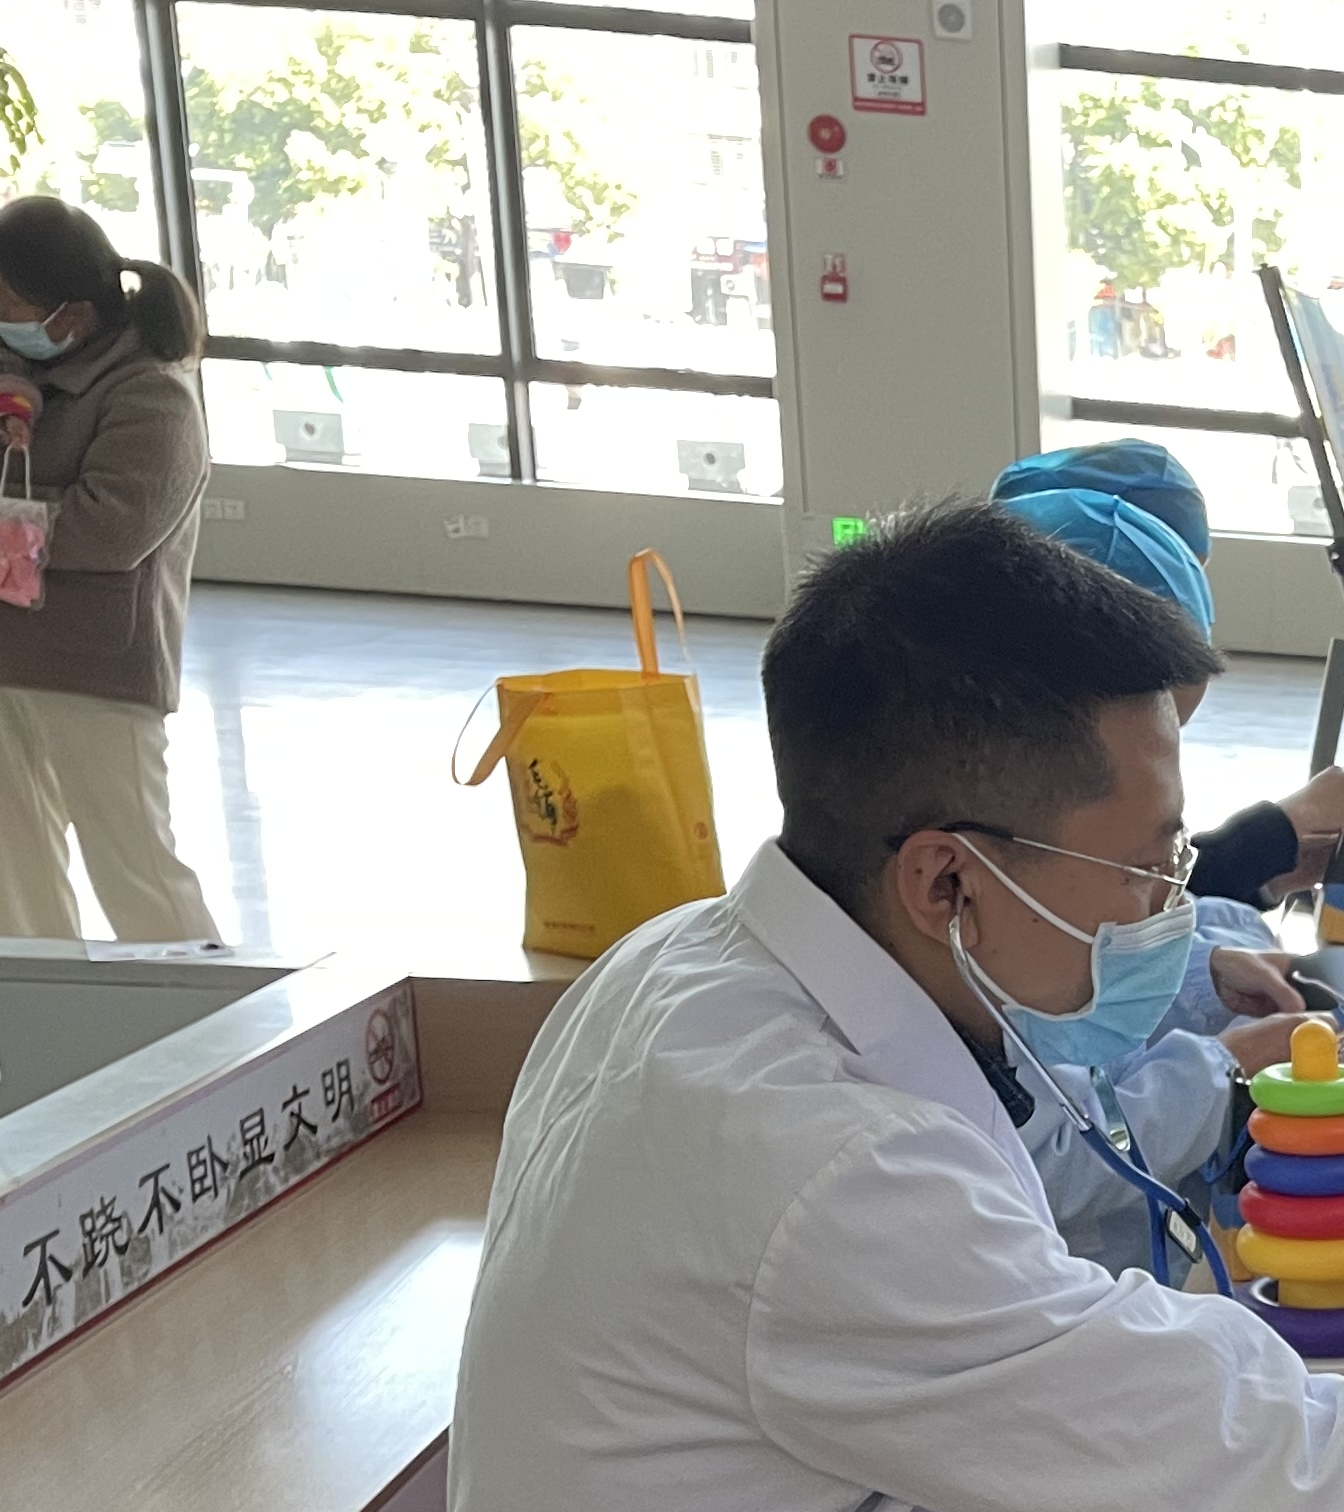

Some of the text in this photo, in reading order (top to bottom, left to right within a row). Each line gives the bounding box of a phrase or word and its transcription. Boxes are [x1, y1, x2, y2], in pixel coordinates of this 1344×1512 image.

[21, 1057, 355, 1309] 不跷不卧显文明
